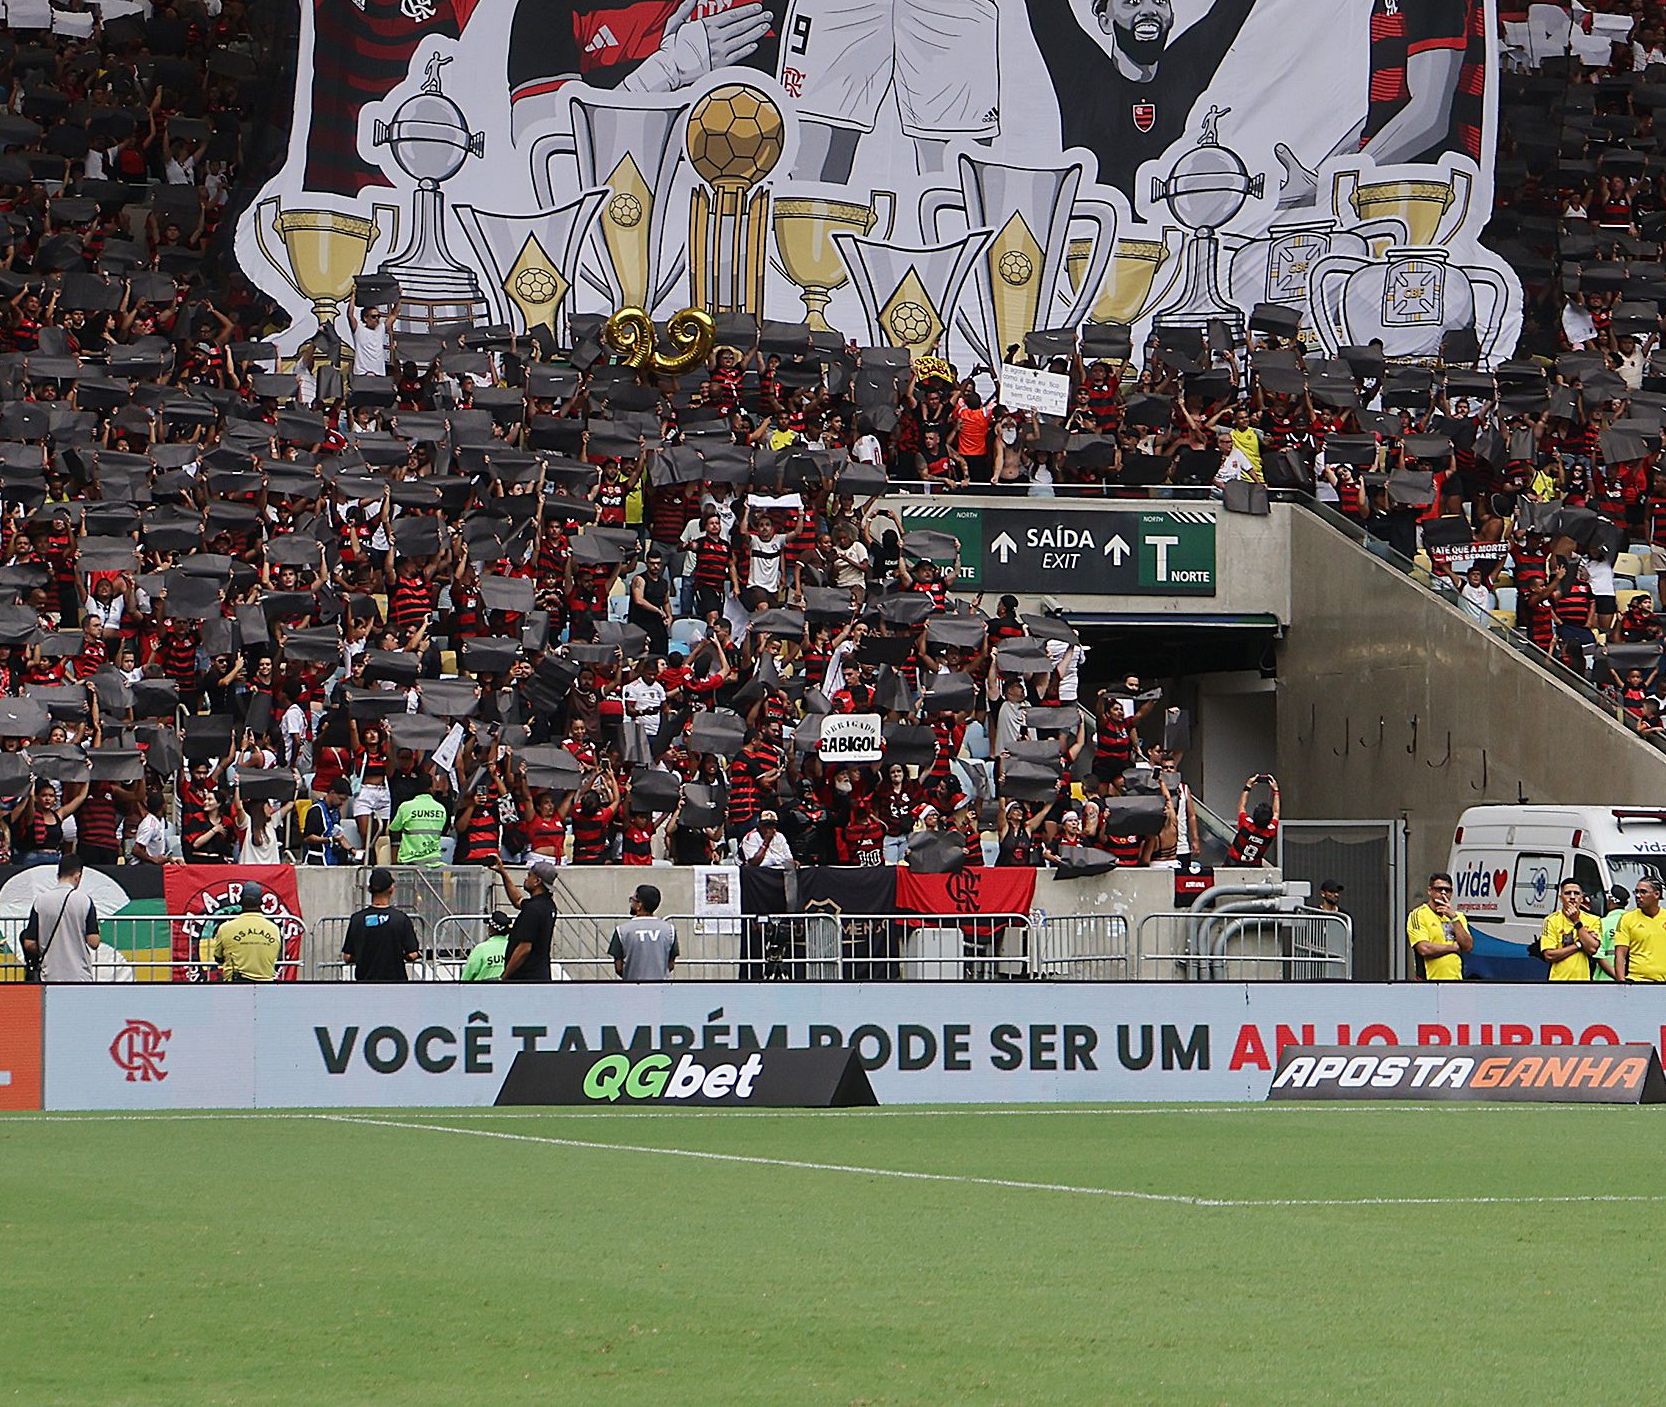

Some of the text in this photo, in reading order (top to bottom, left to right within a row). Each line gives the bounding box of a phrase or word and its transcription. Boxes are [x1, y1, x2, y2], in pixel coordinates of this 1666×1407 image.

[792, 13, 812, 56] 9
[1403, 287, 1425, 300] CBF
[606, 305, 716, 377] 99
[955, 511, 978, 520] NORTH
[1142, 515, 1165, 523] NORTH
[1026, 524, 1096, 550] SAÍDA
[1452, 545, 1469, 554] QUE
[1478, 543, 1507, 553] MORTE
[1042, 552, 1082, 570] EXIT
[1144, 535, 1211, 583] T NORTE
[819, 735, 881, 753] GABIGOL
[410, 809, 446, 821] SUNSET
[1456, 860, 1491, 898] vida
[247, 927, 276, 944] ALADO
[635, 929, 661, 942] TV
[314, 1010, 494, 1075] VOCÊ
[809, 1023, 972, 1072] PODE
[991, 1023, 1099, 1072] SER
[1117, 1023, 1211, 1072] UM
[581, 1053, 764, 1103] QGbet
